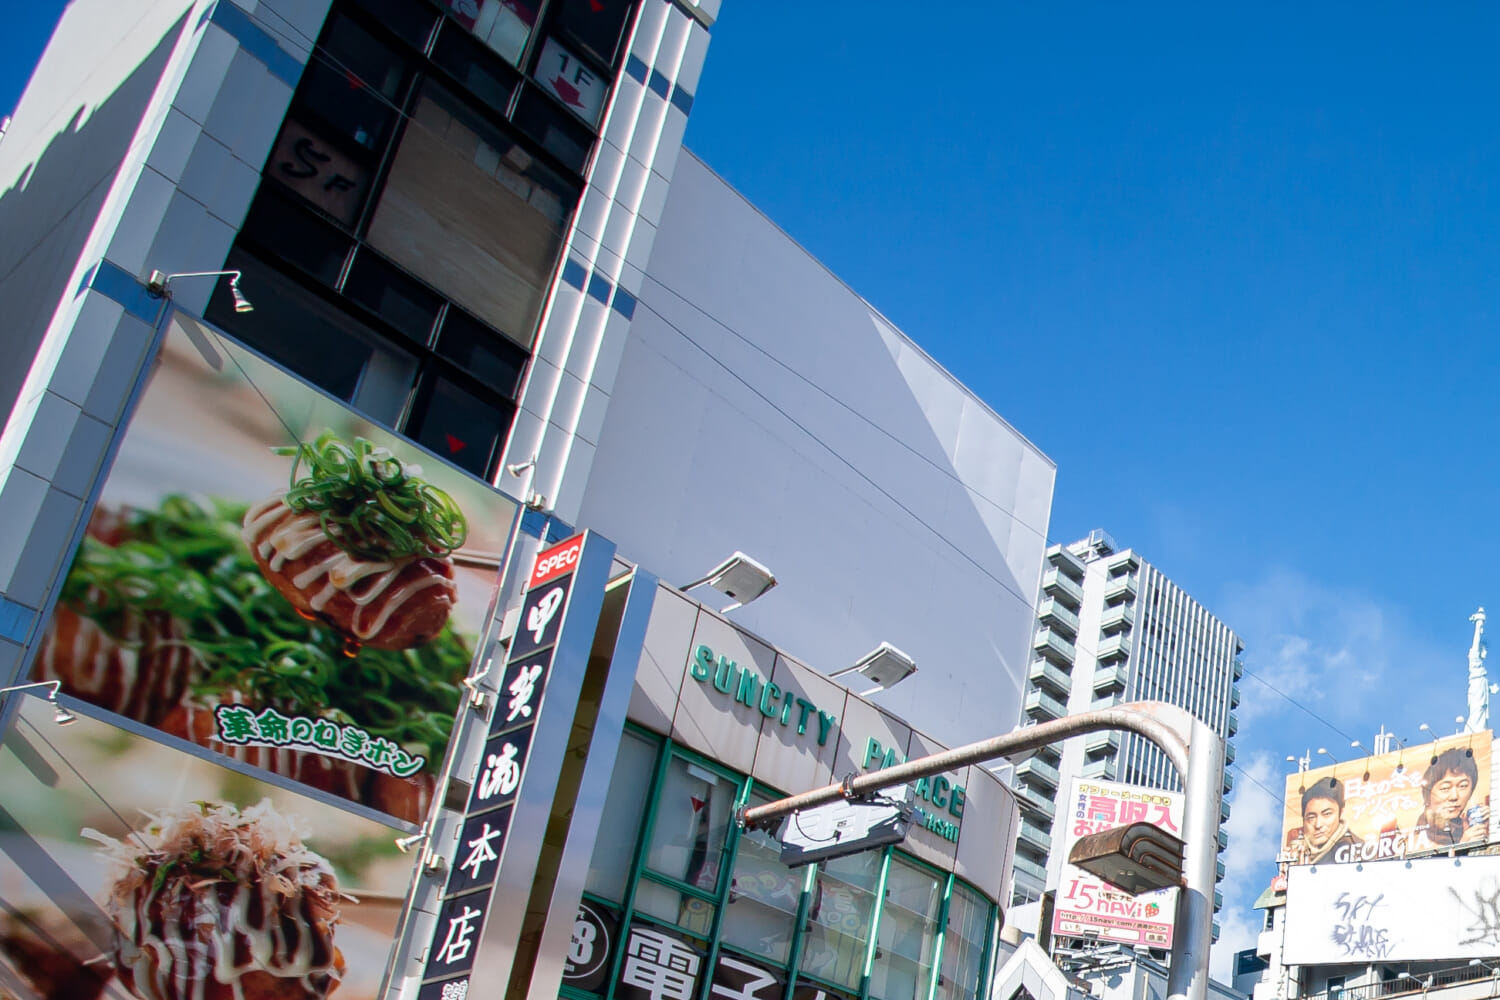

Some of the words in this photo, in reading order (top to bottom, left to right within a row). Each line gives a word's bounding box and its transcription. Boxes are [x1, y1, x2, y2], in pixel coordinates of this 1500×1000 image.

[558, 53, 594, 87] 1F
[536, 543, 580, 578] SPEC
[217, 706, 425, 778] 革命のねぎポン
[690, 644, 836, 746] SUNCITY
[862, 736, 966, 818] PAACE
[435, 586, 564, 967] 甲賀流本店
[1087, 796, 1178, 832] 高収入
[1334, 830, 1431, 864] GEORGIA
[1064, 880, 1098, 910] 15
